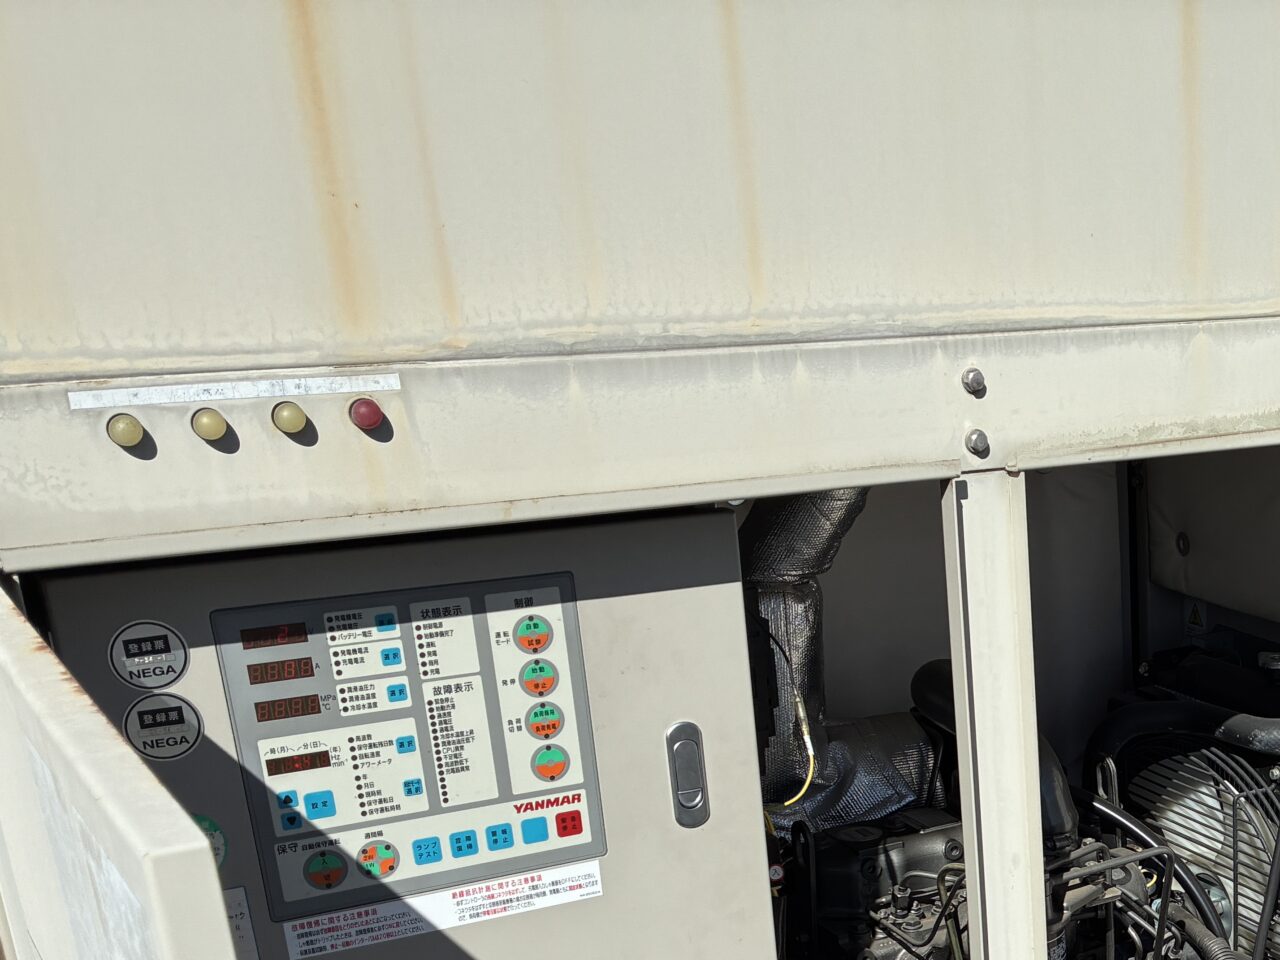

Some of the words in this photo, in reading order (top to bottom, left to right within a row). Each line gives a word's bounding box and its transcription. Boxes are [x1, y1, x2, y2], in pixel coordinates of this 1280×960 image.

[514, 597, 534, 608] 制御
[420, 605, 462, 620] 状態表示
[338, 630, 373, 640] バッテリー電圧
[128, 664, 176, 680] NEGA
[432, 681, 474, 696] 故障表示
[142, 736, 190, 750] NEGA
[360, 758, 392, 768] アワーメータ
[312, 800, 328, 809] 設定
[513, 793, 582, 814] YANMAR
[277, 842, 298, 855] 保守
[416, 842, 437, 851] ランプ
[418, 850, 438, 860] テスト
